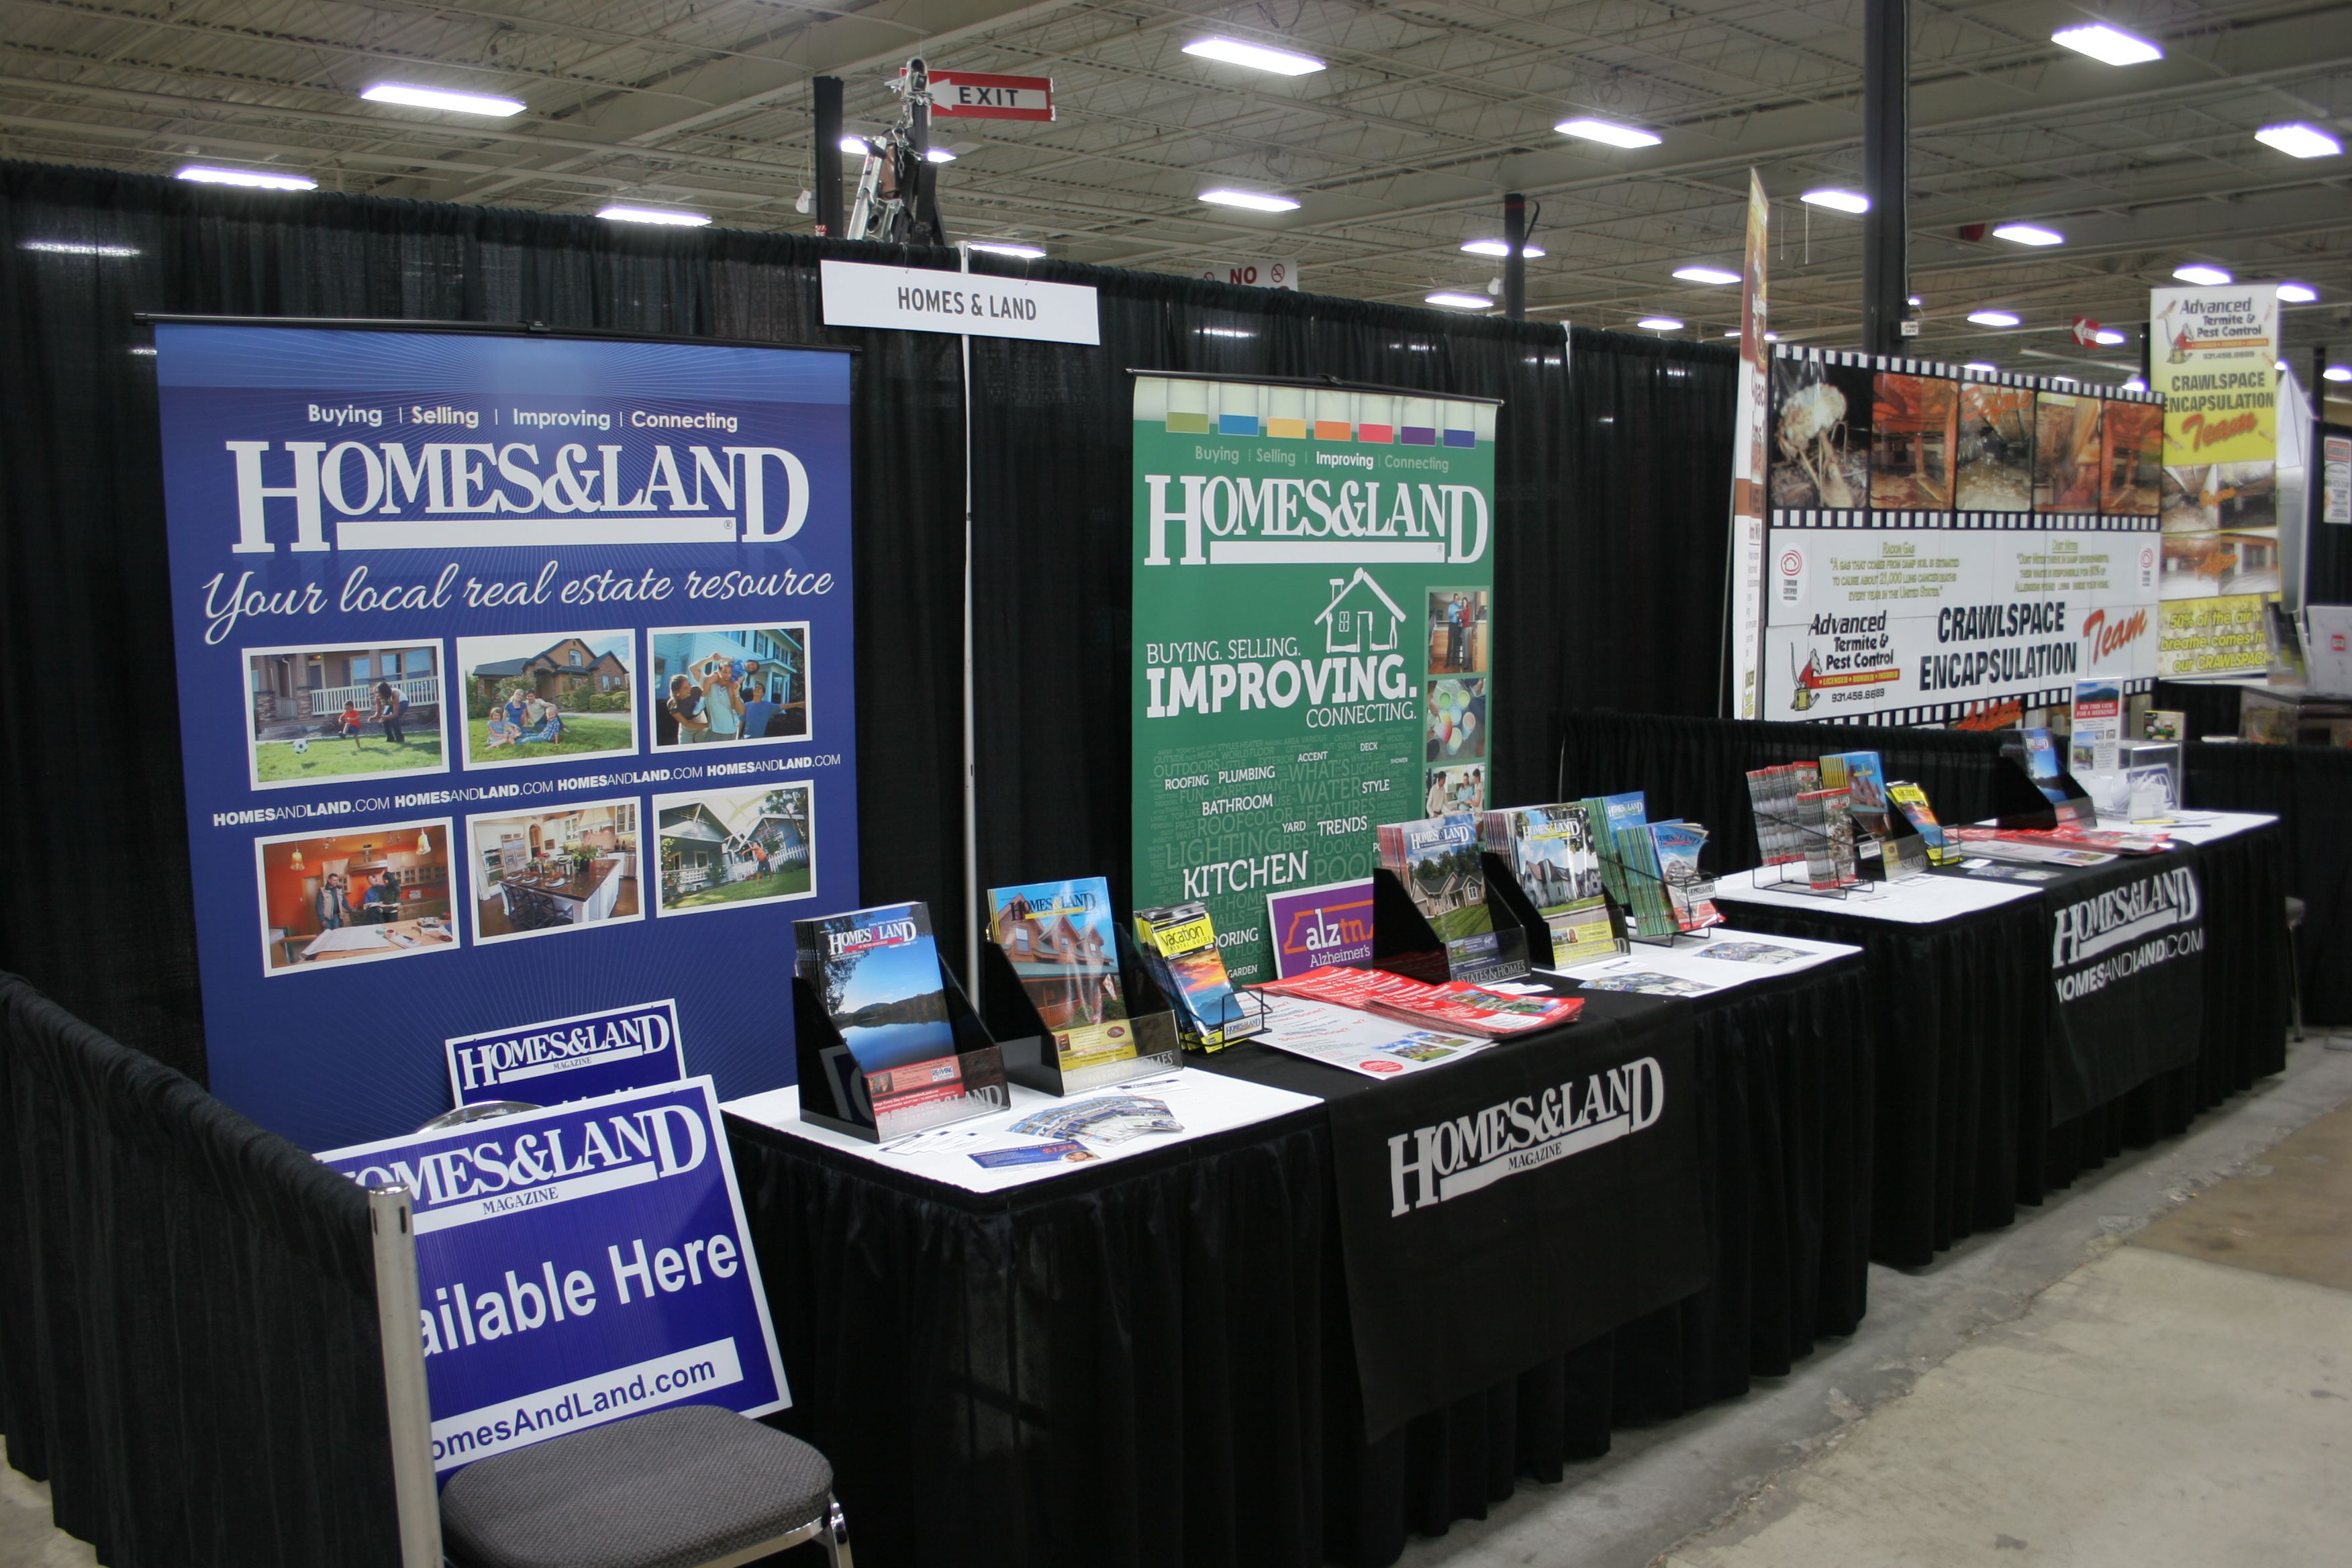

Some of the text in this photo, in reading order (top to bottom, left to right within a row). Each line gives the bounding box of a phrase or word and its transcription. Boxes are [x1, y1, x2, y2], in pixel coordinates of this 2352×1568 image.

[960, 86, 1019, 107] EXIT
[1230, 266, 1257, 285] NO
[898, 287, 1036, 321] HOMES & LAND
[2180, 297, 2251, 315] Advanced
[2197, 324, 2261, 337] Pest Control
[2203, 315, 2243, 326] Termite
[2171, 372, 2265, 391] CRAWLSPACE
[308, 404, 738, 432] Buying Selling Improving Connecting
[2182, 411, 2258, 452] Team
[1195, 446, 1449, 473] Buying Selling Improving Connecting
[226, 441, 809, 554] HOMES&LAND
[1144, 475, 1488, 565] HOMES&LAND
[202, 560, 834, 644] Your local real estate resource
[1808, 609, 1887, 636] Advanced
[1937, 602, 2065, 644] CRAWLSPACE
[2169, 609, 2252, 629] 50% of the air
[1834, 633, 1889, 652] Termite &
[2083, 607, 2147, 665] Team
[2159, 632, 2250, 652] breathe comes
[1146, 637, 1301, 664] BUYING. SELLING.
[1826, 648, 1894, 670] Pest Control
[1919, 642, 2077, 691] ENCAPSULATION
[2173, 659, 2193, 671] our
[1146, 654, 1417, 718] IMPROVING.
[1306, 702, 1417, 728] CONNECTING.
[1297, 751, 1328, 763] ACCENT
[1360, 742, 1378, 751] DECK
[1154, 758, 1220, 778] OUTDOORS
[1289, 758, 1349, 783] WHAT'S
[1165, 765, 1275, 790] ROOFING PLUMBING
[213, 753, 841, 826] HOMESANDLAND.COM HOMESANDLAND.COM HOMESANDLAND.COM HOMESANDLAND.COM
[1179, 789, 1204, 804] FUN
[1212, 784, 1255, 799] CARPET
[1256, 778, 1289, 792] WANT
[1297, 777, 1361, 804] WATER
[1362, 779, 1390, 793] STYLE
[1202, 794, 1273, 816] BATHROOM
[1306, 797, 1375, 821] FEATURES
[1282, 821, 1306, 833] YARD
[1317, 816, 1367, 836] TRENDS
[1410, 826, 1469, 850] HOMES&LAND
[1166, 828, 1281, 869] LIGHTING
[1183, 850, 1308, 900] KITCHEN
[2053, 867, 2196, 968] HOMES&LAND
[1161, 925, 1204, 946] vacation
[1310, 944, 1371, 968] Alzheimer's
[1228, 965, 1258, 978] GARDEN
[458, 1013, 670, 1091] HOMES&LAND
[552, 1057, 592, 1071] MAGAZINE
[1387, 1056, 1664, 1218] HOMES&LAND
[1508, 1142, 1562, 1171] MAGAZINE
[482, 1187, 558, 1215] MAGAZINE
[607, 1234, 738, 1305] Here
[432, 1359, 716, 1461] omesAndLand.com
